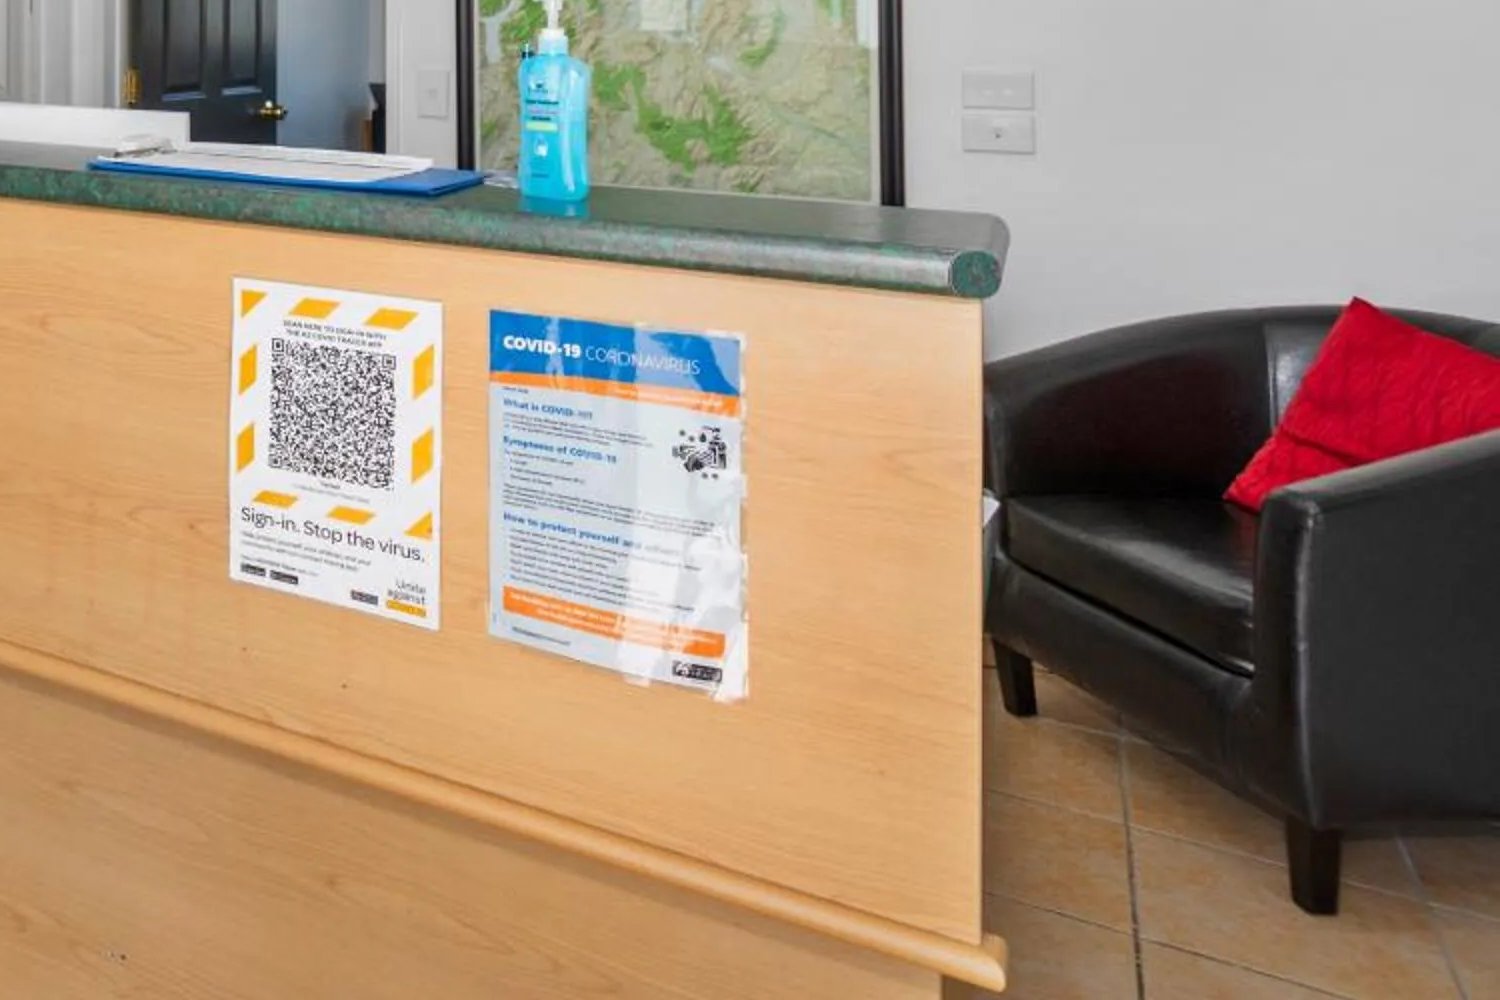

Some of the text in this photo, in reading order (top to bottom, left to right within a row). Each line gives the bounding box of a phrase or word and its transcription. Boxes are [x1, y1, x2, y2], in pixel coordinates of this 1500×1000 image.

[503, 335, 701, 375] COVID-19 CORONAVIRUS
[503, 397, 529, 411] What
[531, 402, 539, 412] is
[503, 435, 554, 454] Symptoms
[557, 444, 568, 455] of
[241, 506, 300, 532] Sign-in.
[303, 520, 343, 545] Stop
[346, 530, 375, 551] the
[379, 543, 426, 563] virus.
[503, 510, 526, 524] How
[528, 516, 539, 527] to
[540, 520, 576, 537] protect
[579, 528, 620, 545] yourself
